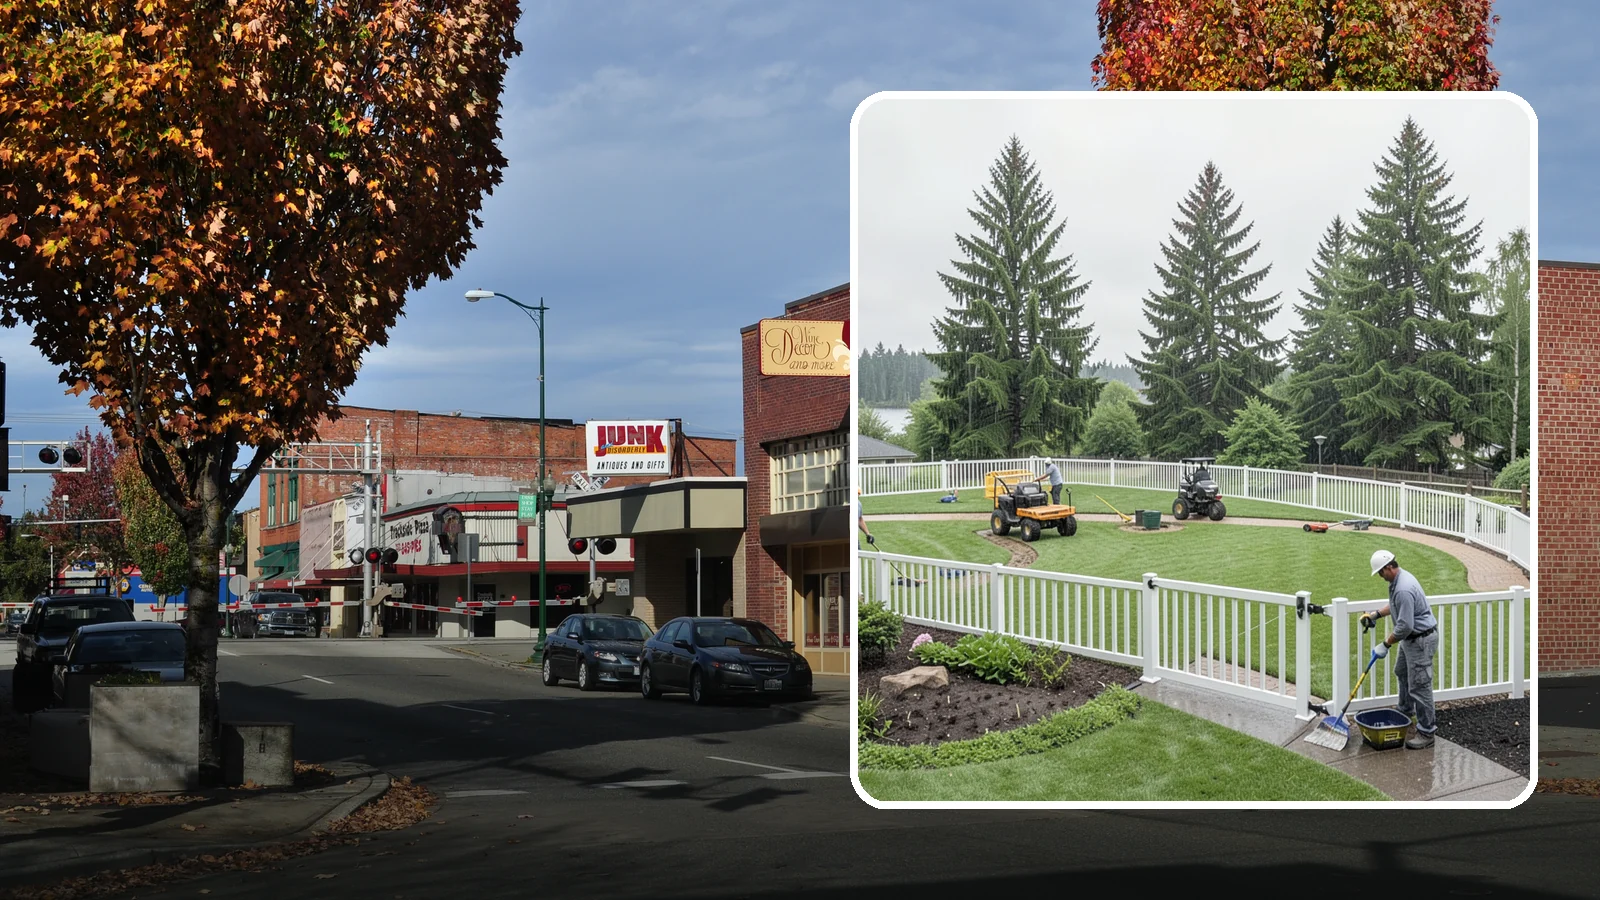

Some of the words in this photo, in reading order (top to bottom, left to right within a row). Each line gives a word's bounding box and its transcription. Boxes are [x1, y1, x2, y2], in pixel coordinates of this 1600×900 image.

[765, 328, 831, 365] Decor
[596, 425, 665, 457] JUNK
[608, 446, 646, 454] DISORDERLY
[597, 461, 628, 470] ANTIQUES
[631, 461, 643, 470] AND
[647, 460, 665, 469] GIFTS
[390, 521, 412, 540] Trackside
[414, 519, 429, 535] Pizza
